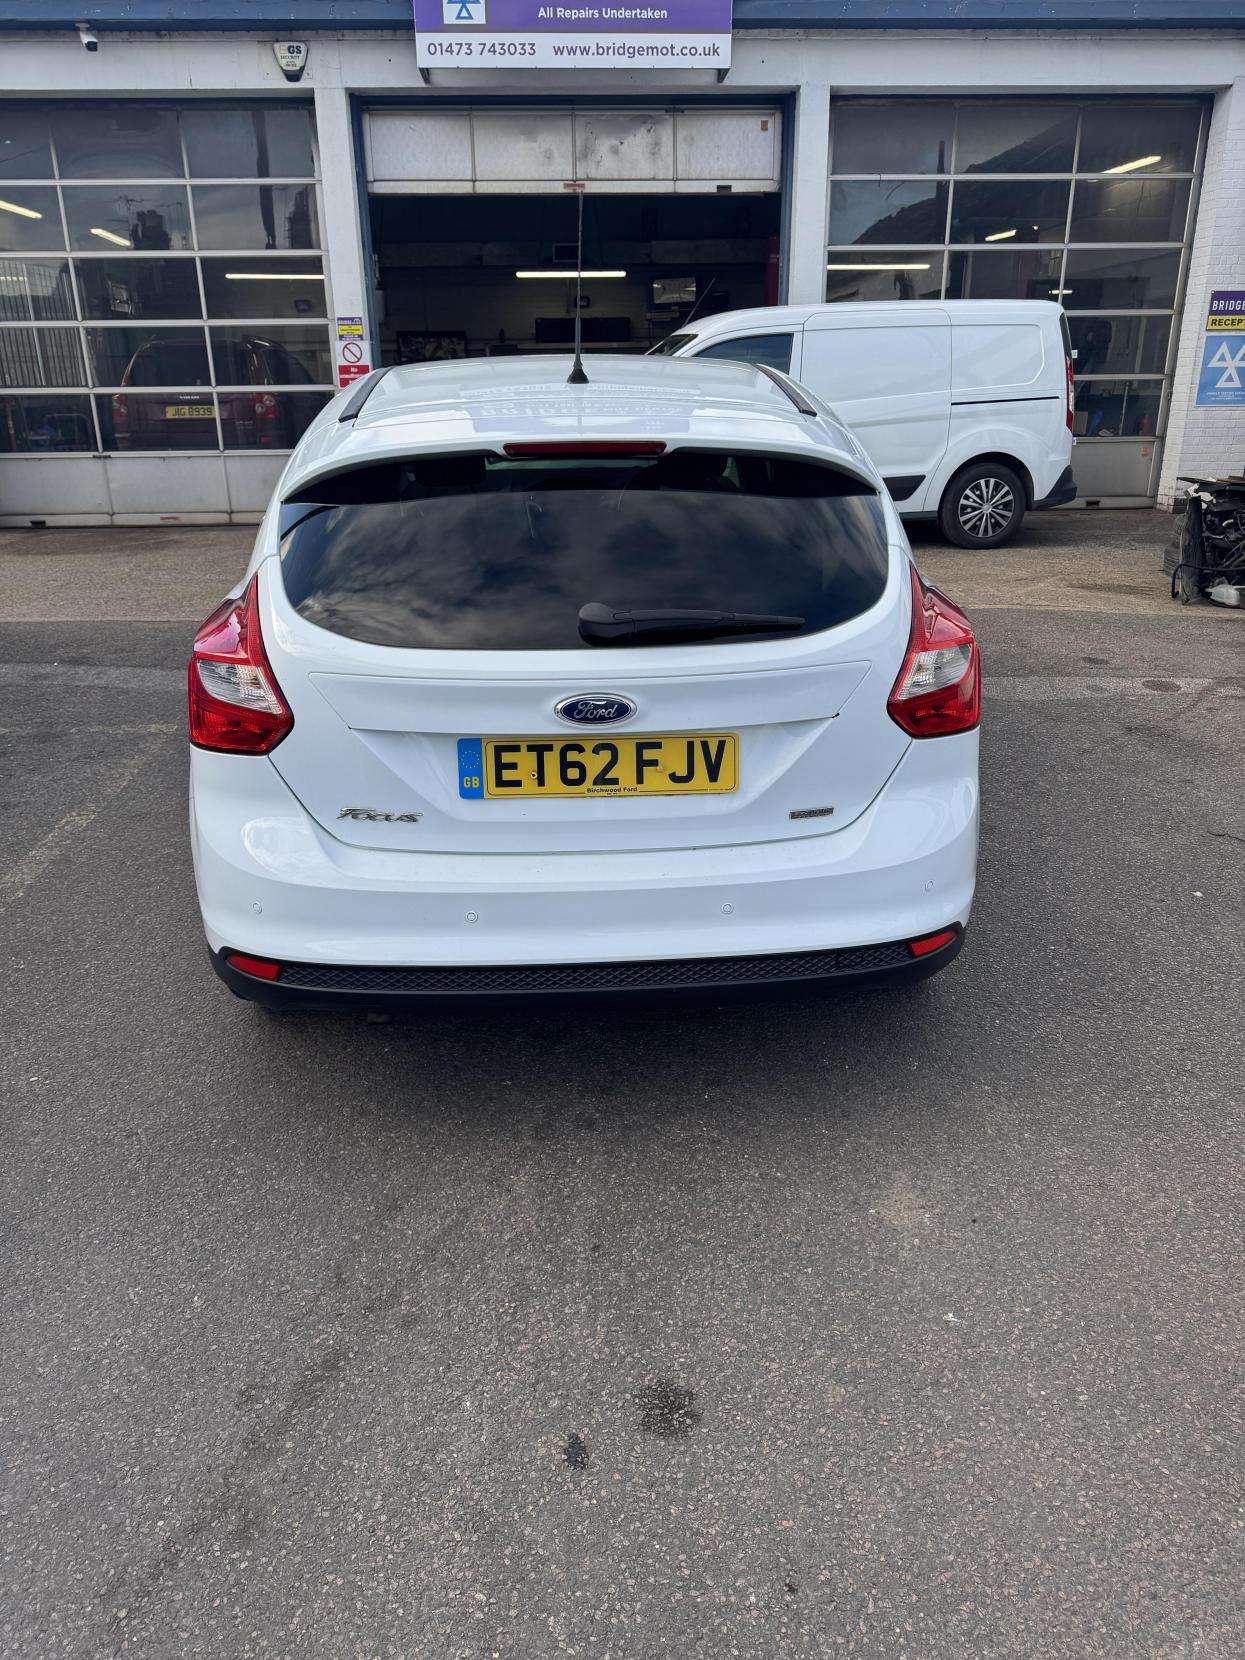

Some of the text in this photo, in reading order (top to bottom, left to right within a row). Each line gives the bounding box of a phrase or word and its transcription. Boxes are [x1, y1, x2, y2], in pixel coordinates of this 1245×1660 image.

[537, 7, 668, 20] All Repairs Undertaken
[287, 45, 302, 54] GS
[427, 42, 721, 59] 01473 743033 www.bridgemot.co.uk
[573, 700, 618, 720] Ford
[493, 739, 727, 788] ET62 FJV
[464, 776, 479, 788] GB
[336, 807, 424, 822] Focus
